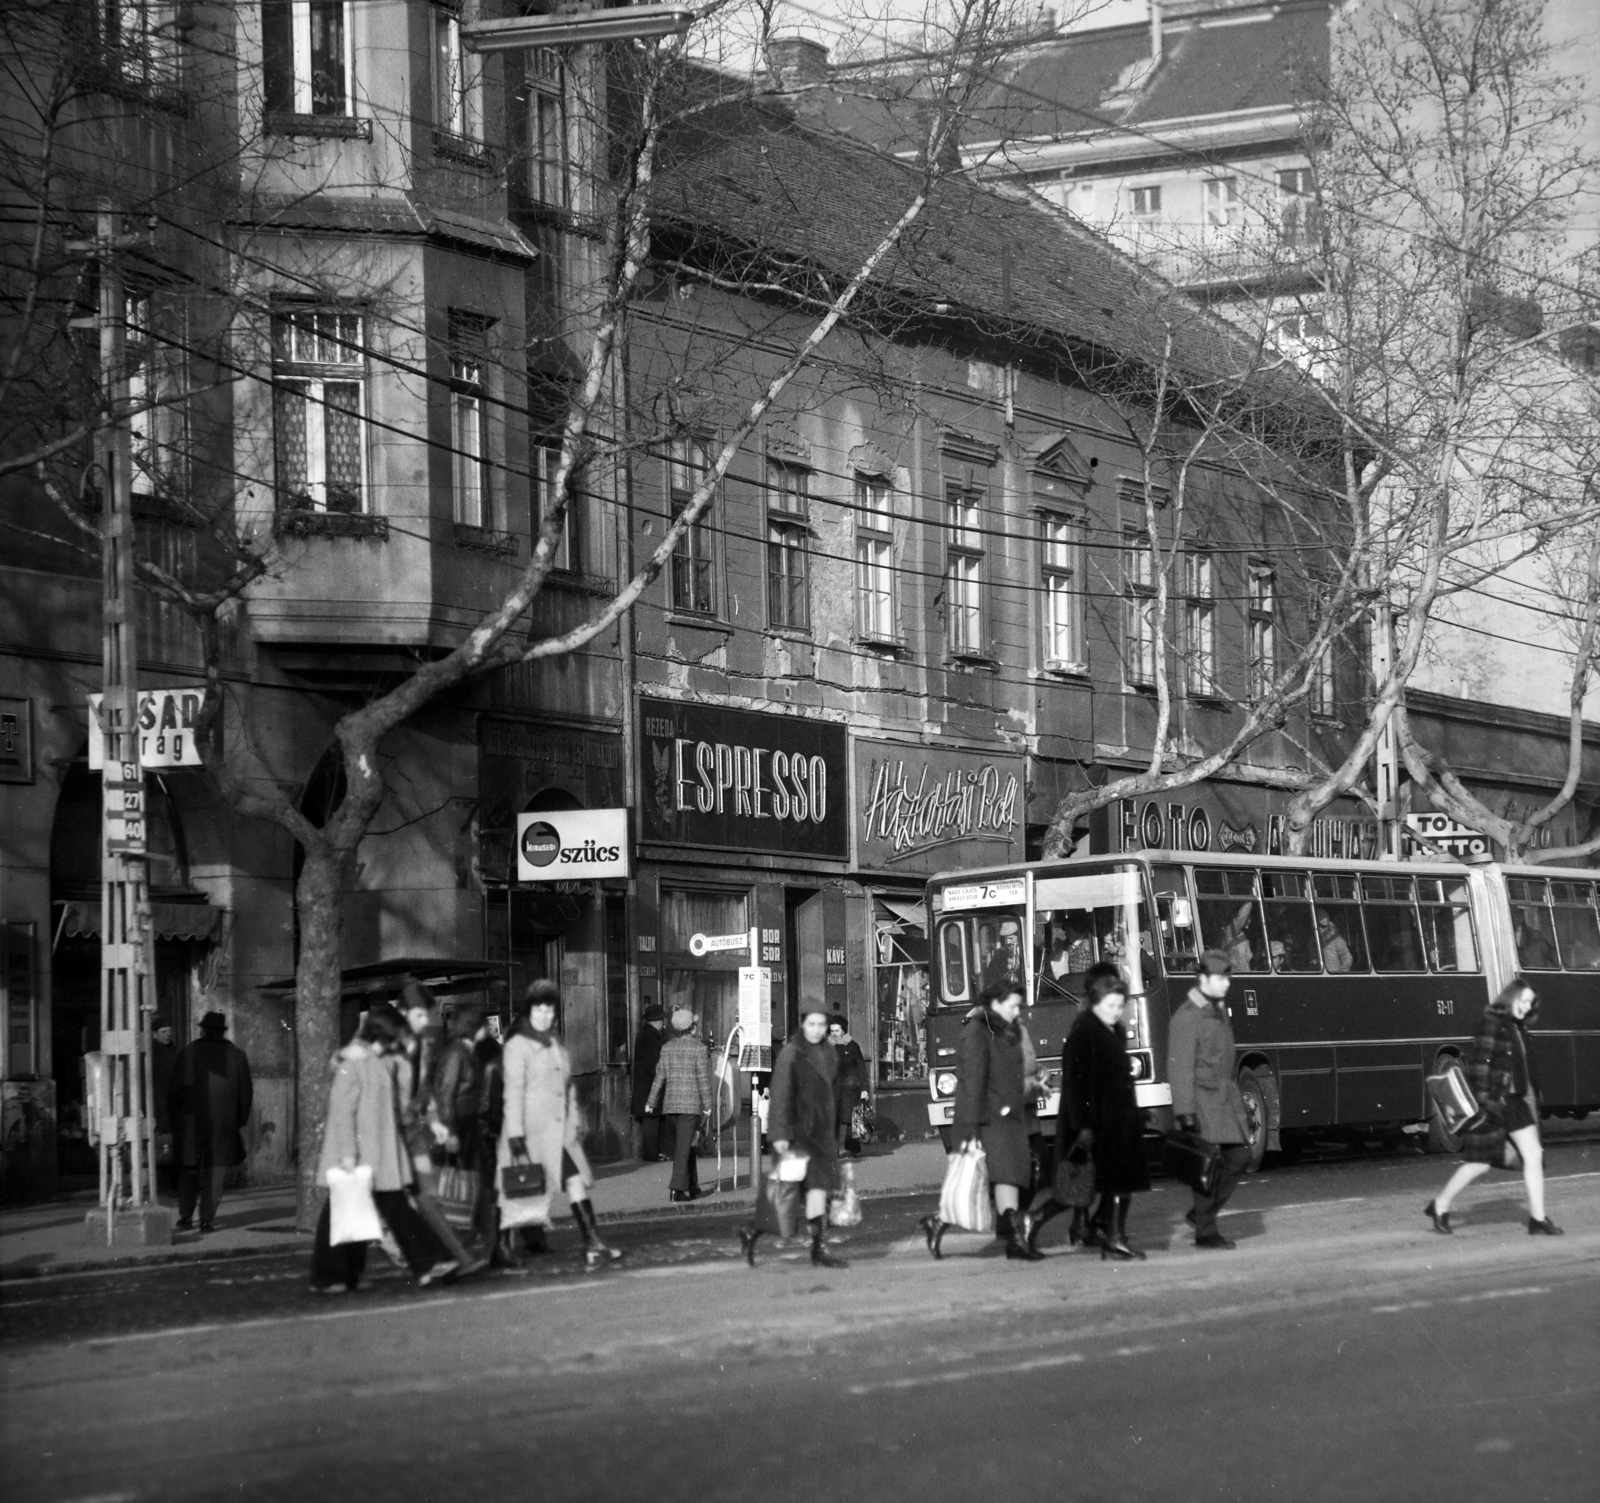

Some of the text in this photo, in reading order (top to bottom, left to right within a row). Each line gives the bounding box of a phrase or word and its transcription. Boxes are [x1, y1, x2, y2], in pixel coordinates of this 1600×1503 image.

[645, 716, 675, 738] REZEDA
[141, 734, 182, 762] rag
[123, 763, 137, 779] 61
[675, 738, 827, 824] ESPRESSO
[125, 792, 139, 809] 27
[976, 764, 1019, 833] Bolt
[126, 822, 141, 838] 40
[1120, 799, 1212, 853] FOTO
[1417, 816, 1475, 832] TOT
[560, 839, 620, 863] szűcs
[711, 937, 743, 948] AUTÓBUSZ
[762, 928, 781, 945] BOR
[826, 946, 845, 965] KÁVÉ
[743, 973, 755, 981] 7C
[1437, 1000, 1454, 1015] 52-17
